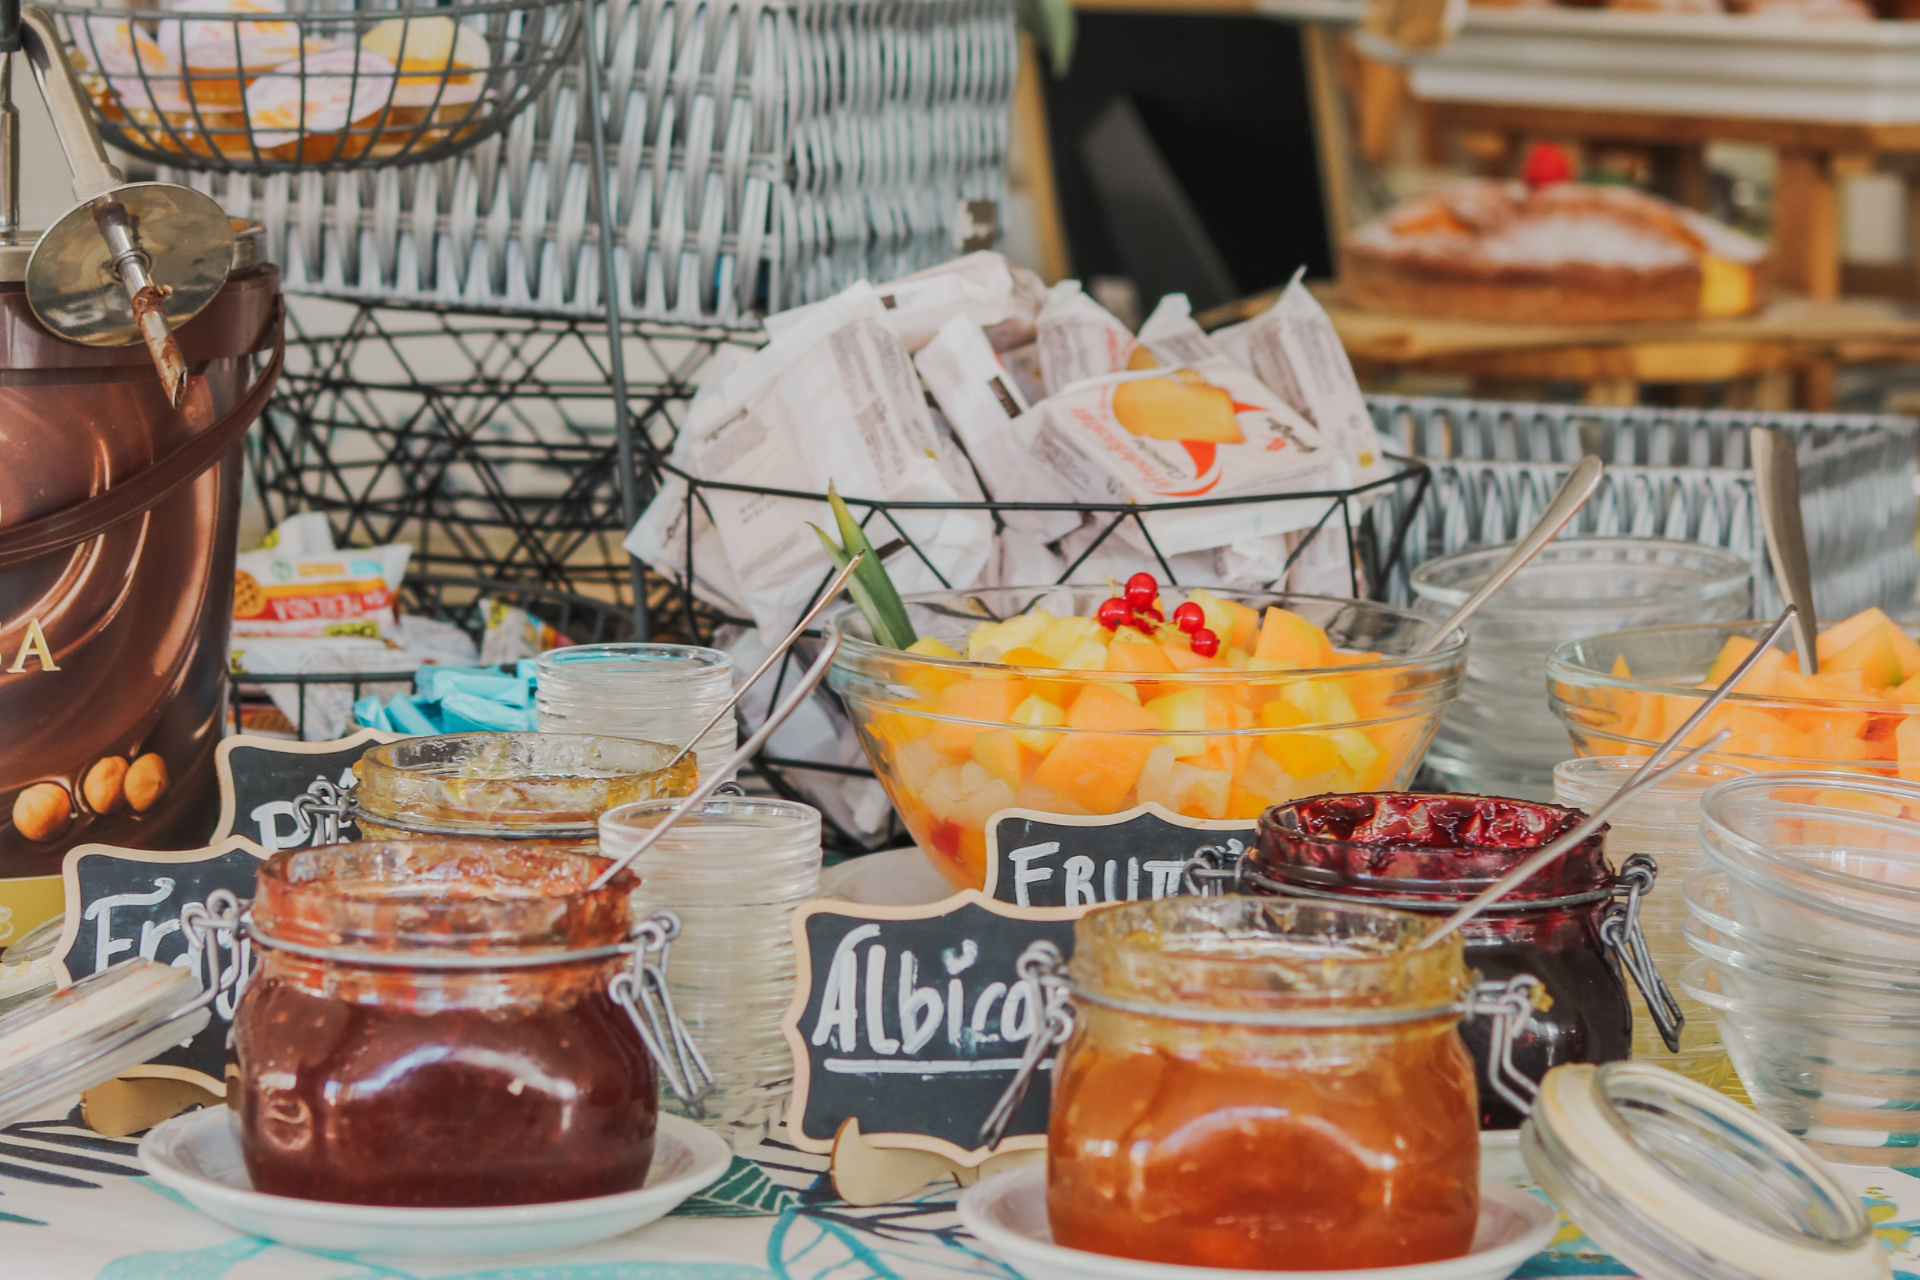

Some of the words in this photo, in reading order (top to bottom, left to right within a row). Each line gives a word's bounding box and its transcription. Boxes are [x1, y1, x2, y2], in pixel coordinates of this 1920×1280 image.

[0, 618, 61, 674] A
[1008, 839, 1244, 907] FRUTT
[811, 923, 1040, 1055] Albico
